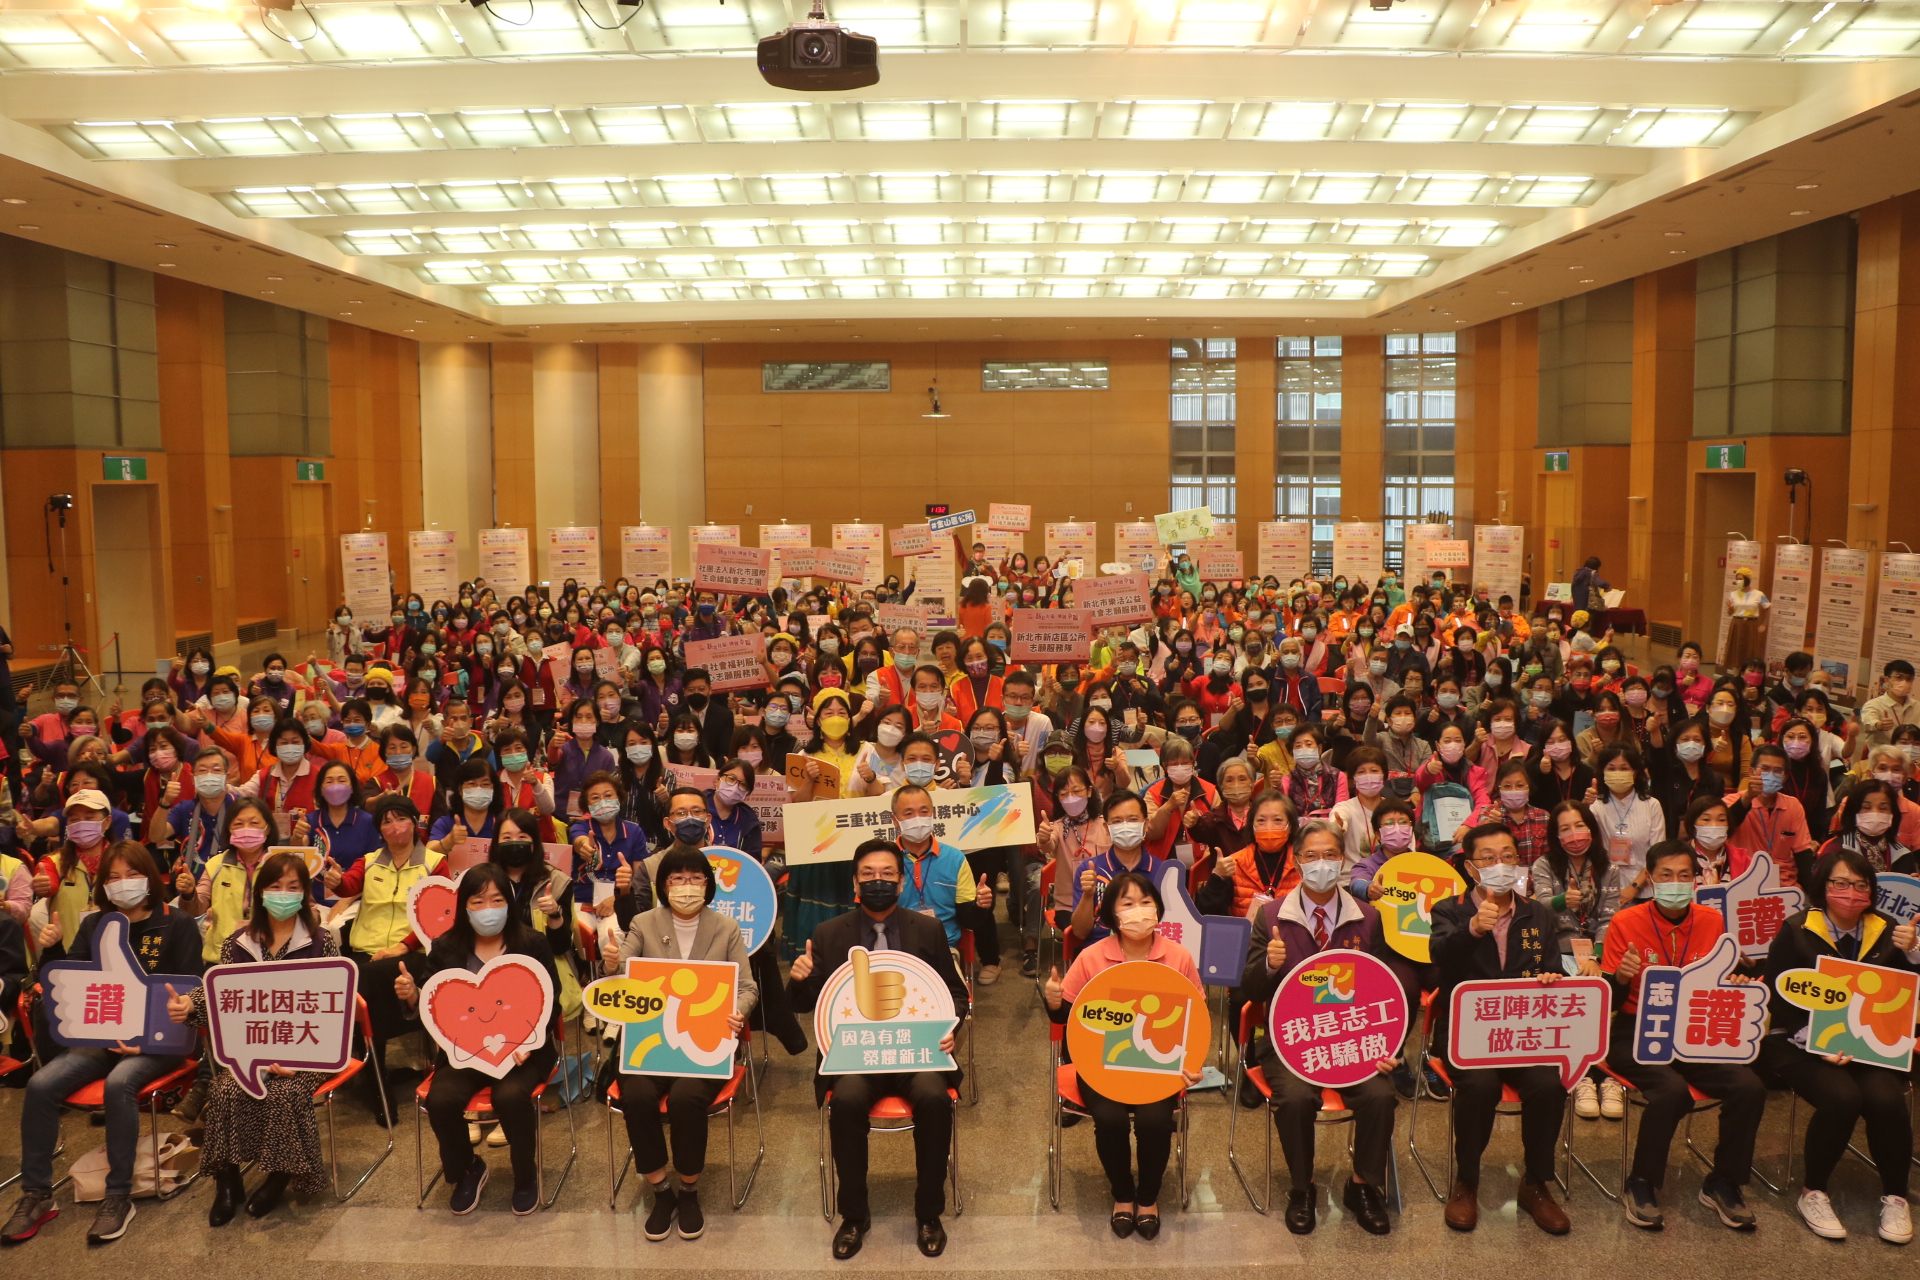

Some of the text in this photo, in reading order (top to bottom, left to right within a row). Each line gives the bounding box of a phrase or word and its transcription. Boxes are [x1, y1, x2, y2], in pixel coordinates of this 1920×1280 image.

[699, 564, 766, 577] 社團法人新北市國際
[702, 574, 762, 587] 生命線協會志工團
[1083, 595, 1142, 609] 新北市樂活公益
[1016, 632, 1086, 642] 新北市新店區公所
[1029, 643, 1073, 653] 志願服務隊
[836, 803, 981, 828] 三重社會務中心
[873, 823, 946, 842] 志願隊
[1383, 886, 1417, 902] et'sgo
[83, 983, 125, 1026] 讚
[219, 988, 345, 1015] 新北因志工
[1474, 993, 1587, 1022] 逗陣來去
[1281, 997, 1399, 1047] 我是志工
[1686, 989, 1746, 1047] 讚
[245, 1020, 320, 1046] 而偉大
[841, 1028, 912, 1047] 因為有您
[1487, 1025, 1571, 1053] 做志工
[863, 1046, 933, 1066] 榮耀新北
[1301, 1032, 1389, 1074] 我驕傲
